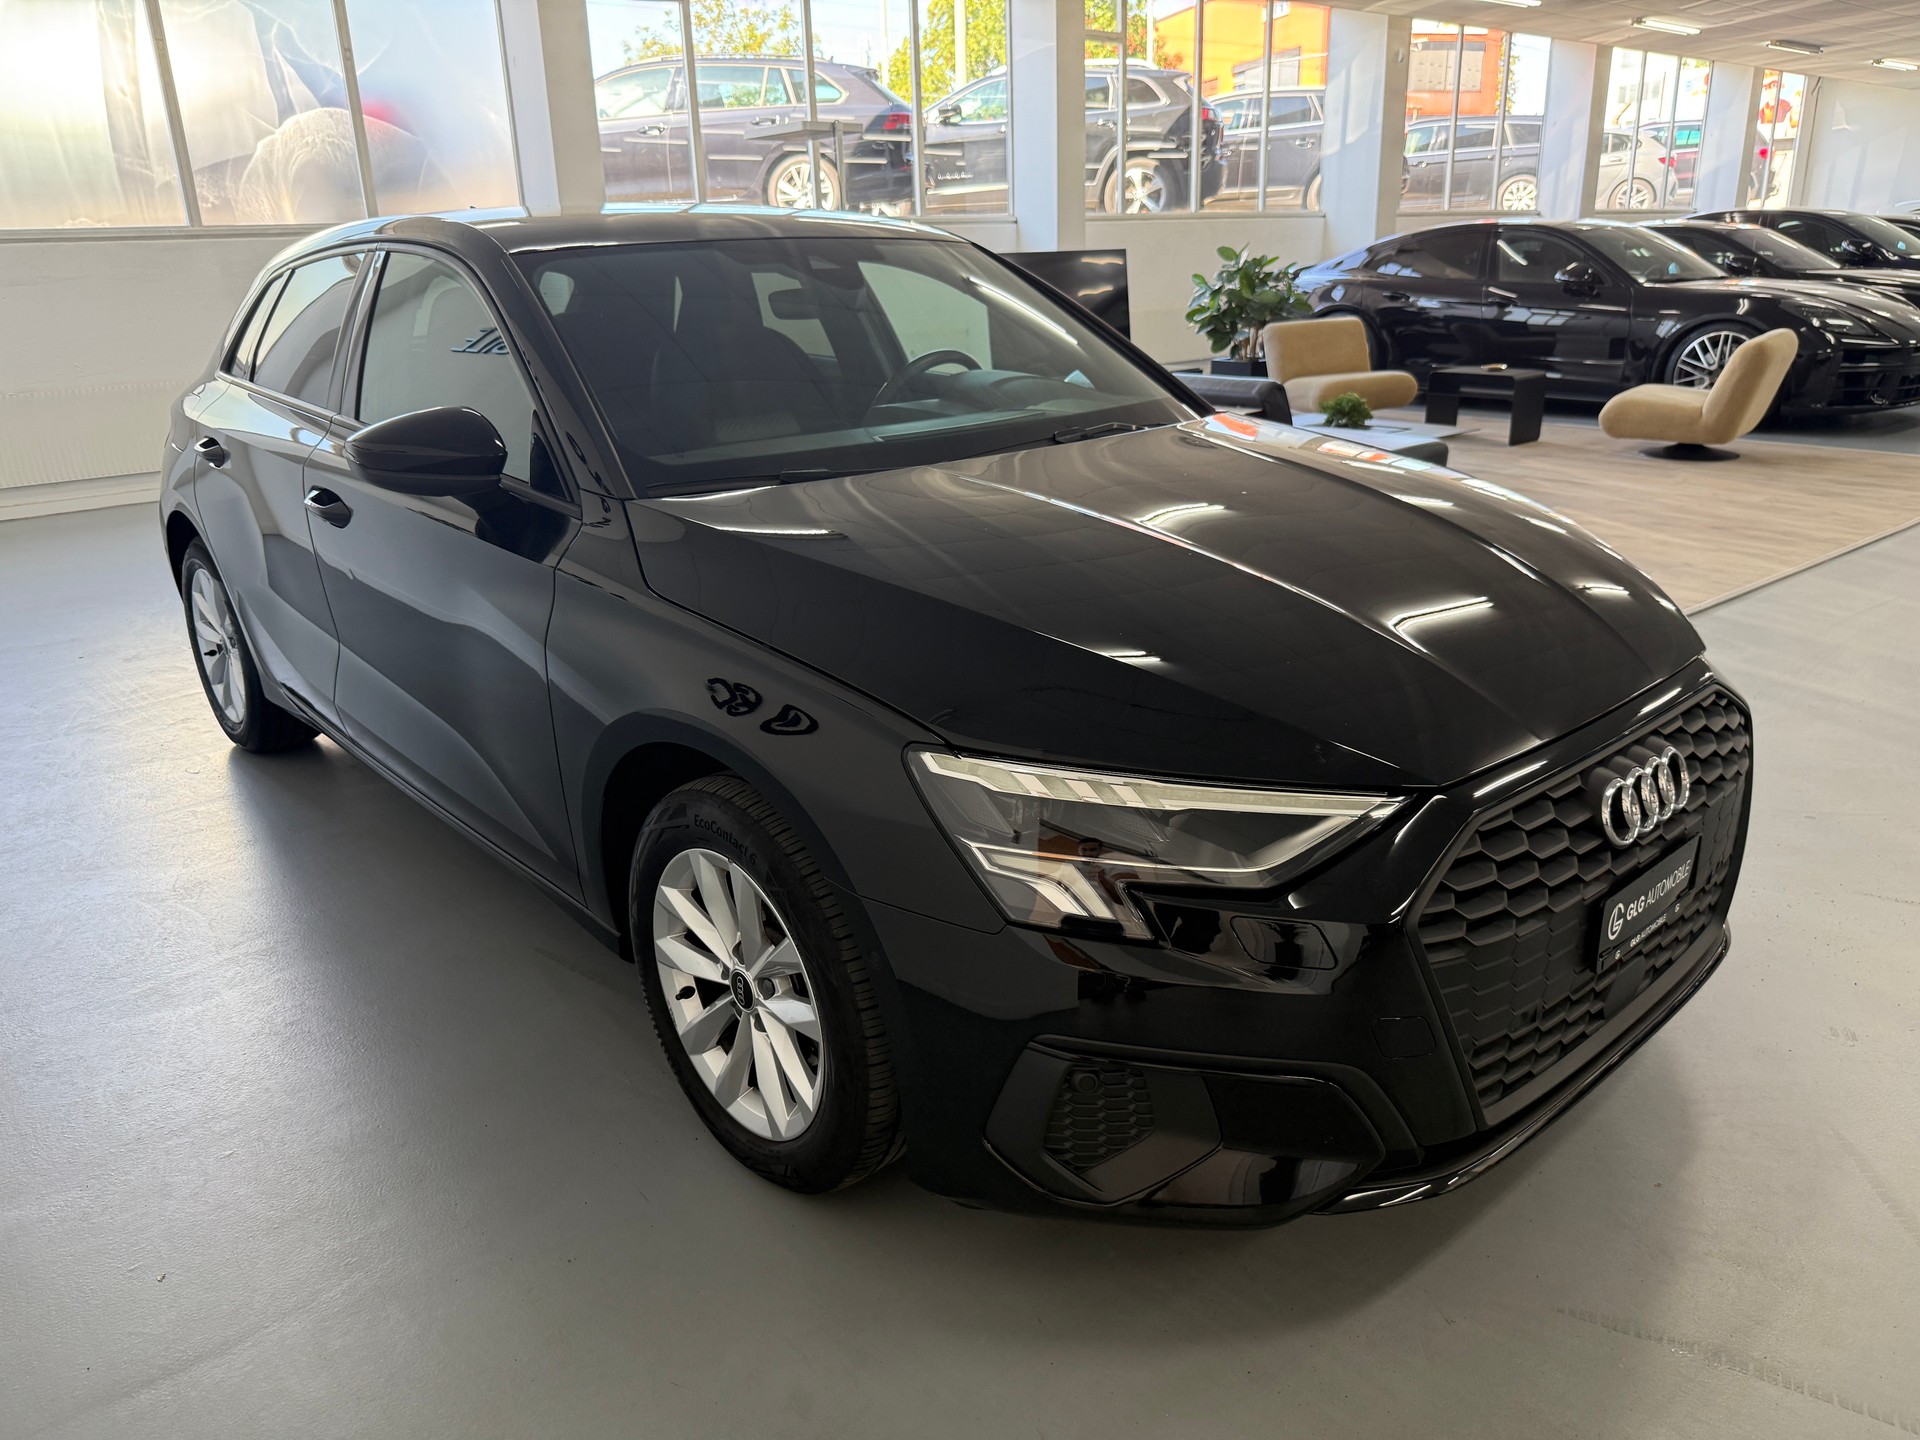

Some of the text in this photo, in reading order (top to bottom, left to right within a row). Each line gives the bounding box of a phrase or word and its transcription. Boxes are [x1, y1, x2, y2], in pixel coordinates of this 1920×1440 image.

[694, 814, 757, 866] EcoContact 6
[1626, 859, 1691, 921] GLG AUTOMOBILE
